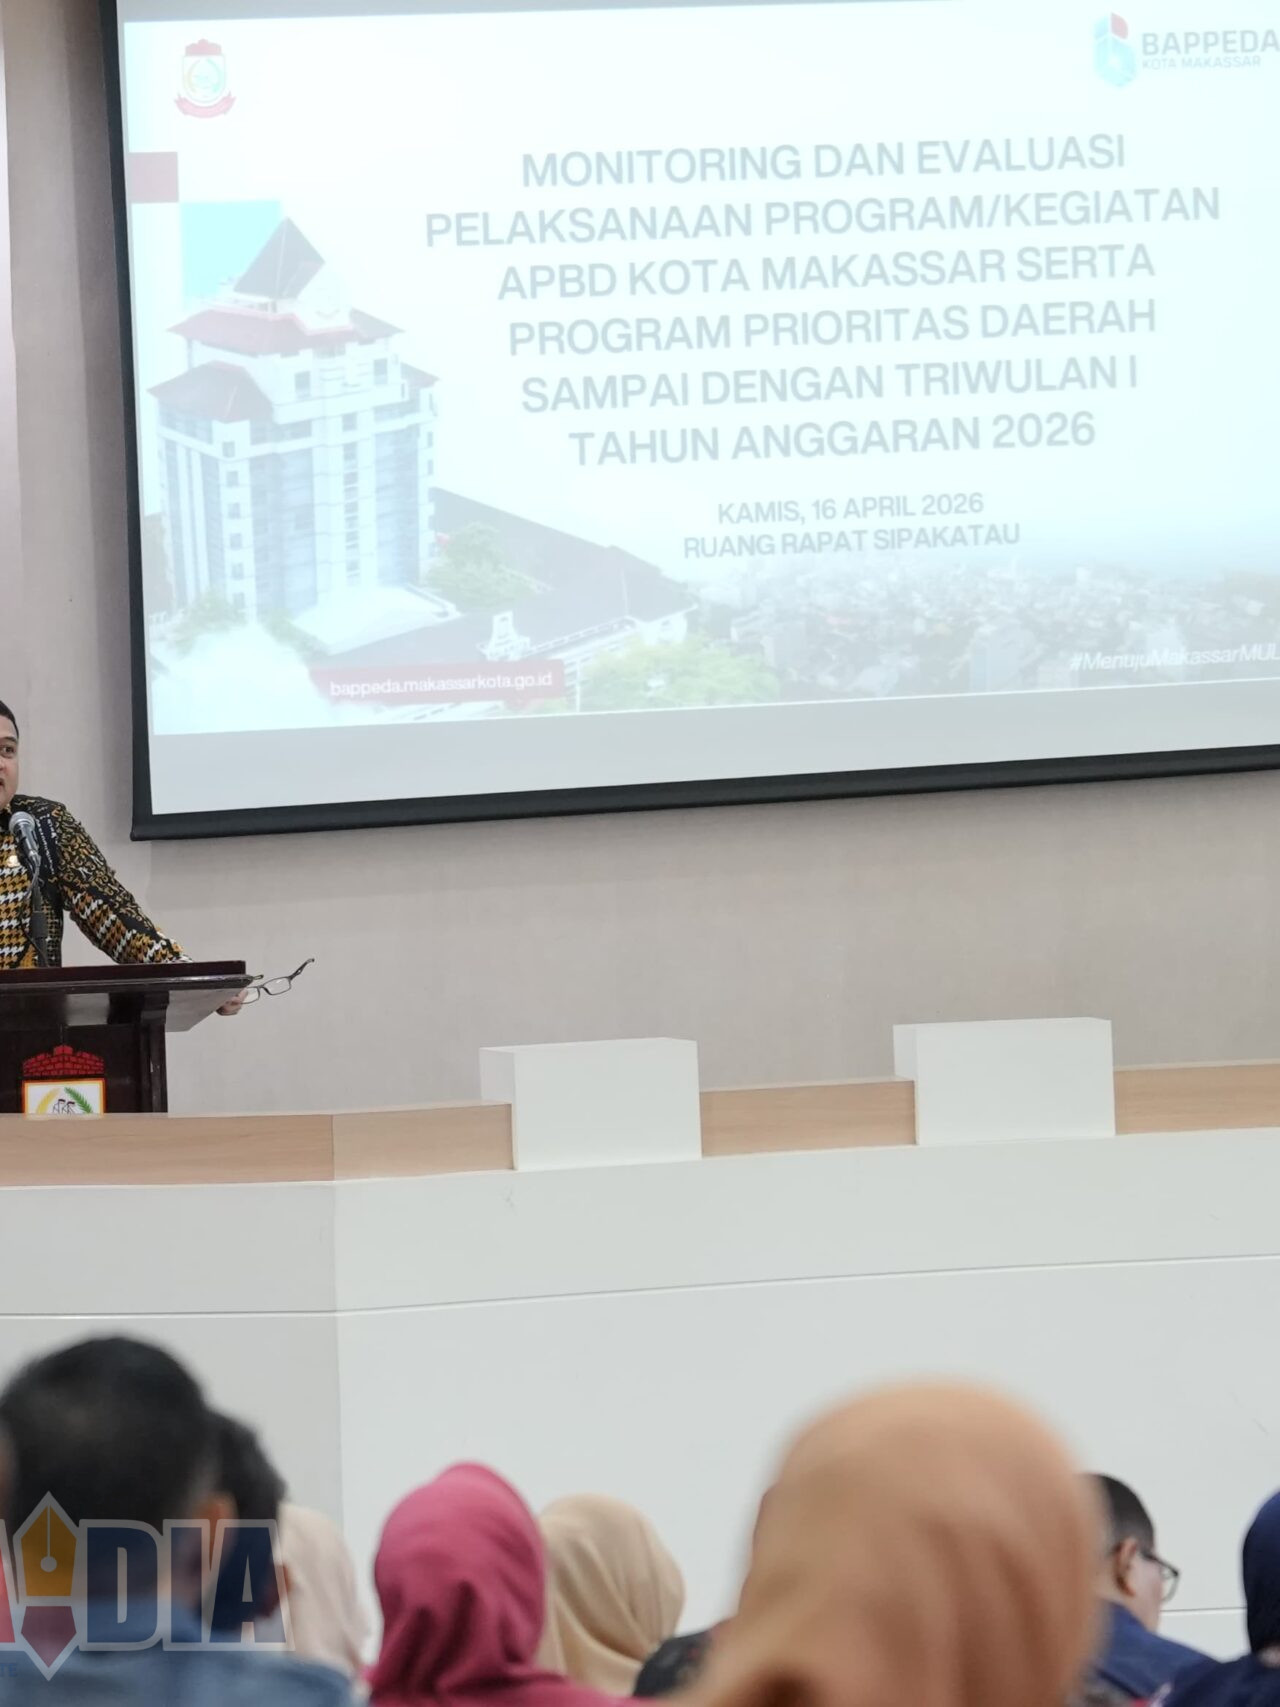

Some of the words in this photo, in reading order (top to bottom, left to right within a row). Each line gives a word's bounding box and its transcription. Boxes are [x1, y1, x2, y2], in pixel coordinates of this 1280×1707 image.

[1141, 29, 1280, 56] BAPPEDA
[1141, 58, 1177, 70] KOTA
[1181, 55, 1261, 69] MAKASSAR
[522, 144, 802, 188] MONITORING
[813, 141, 905, 179] DAN
[916, 134, 1125, 175] EVALUASI
[425, 203, 753, 247] PELAKSANAAN
[764, 187, 1220, 236] PROGRAM/KEGIATAN
[497, 263, 618, 300] APBD
[628, 258, 751, 296] KOTA
[761, 249, 1006, 291] MAKASSAR
[1016, 243, 1156, 282] SERTA
[509, 315, 732, 356] PROGRAM
[743, 305, 970, 348] PRIORITAS
[980, 298, 1156, 339] DAERAH
[521, 372, 689, 413] SAMPAI
[701, 364, 884, 406] DENGAN
[894, 355, 1118, 397] TRIWULAN
[1128, 354, 1138, 388] I
[568, 427, 720, 466] TAHUN
[730, 416, 981, 460] ANGGARAN
[991, 410, 1096, 449] 2026
[717, 499, 806, 526] KAMIS,
[811, 498, 837, 521] 16
[843, 495, 917, 520] APRIL
[922, 492, 985, 516] 2026
[683, 534, 776, 560] RUANG
[781, 529, 869, 555] RAPAT
[873, 522, 1021, 551] SIPAKATAU
[329, 671, 554, 699] bappeda.makassarkota.go.id
